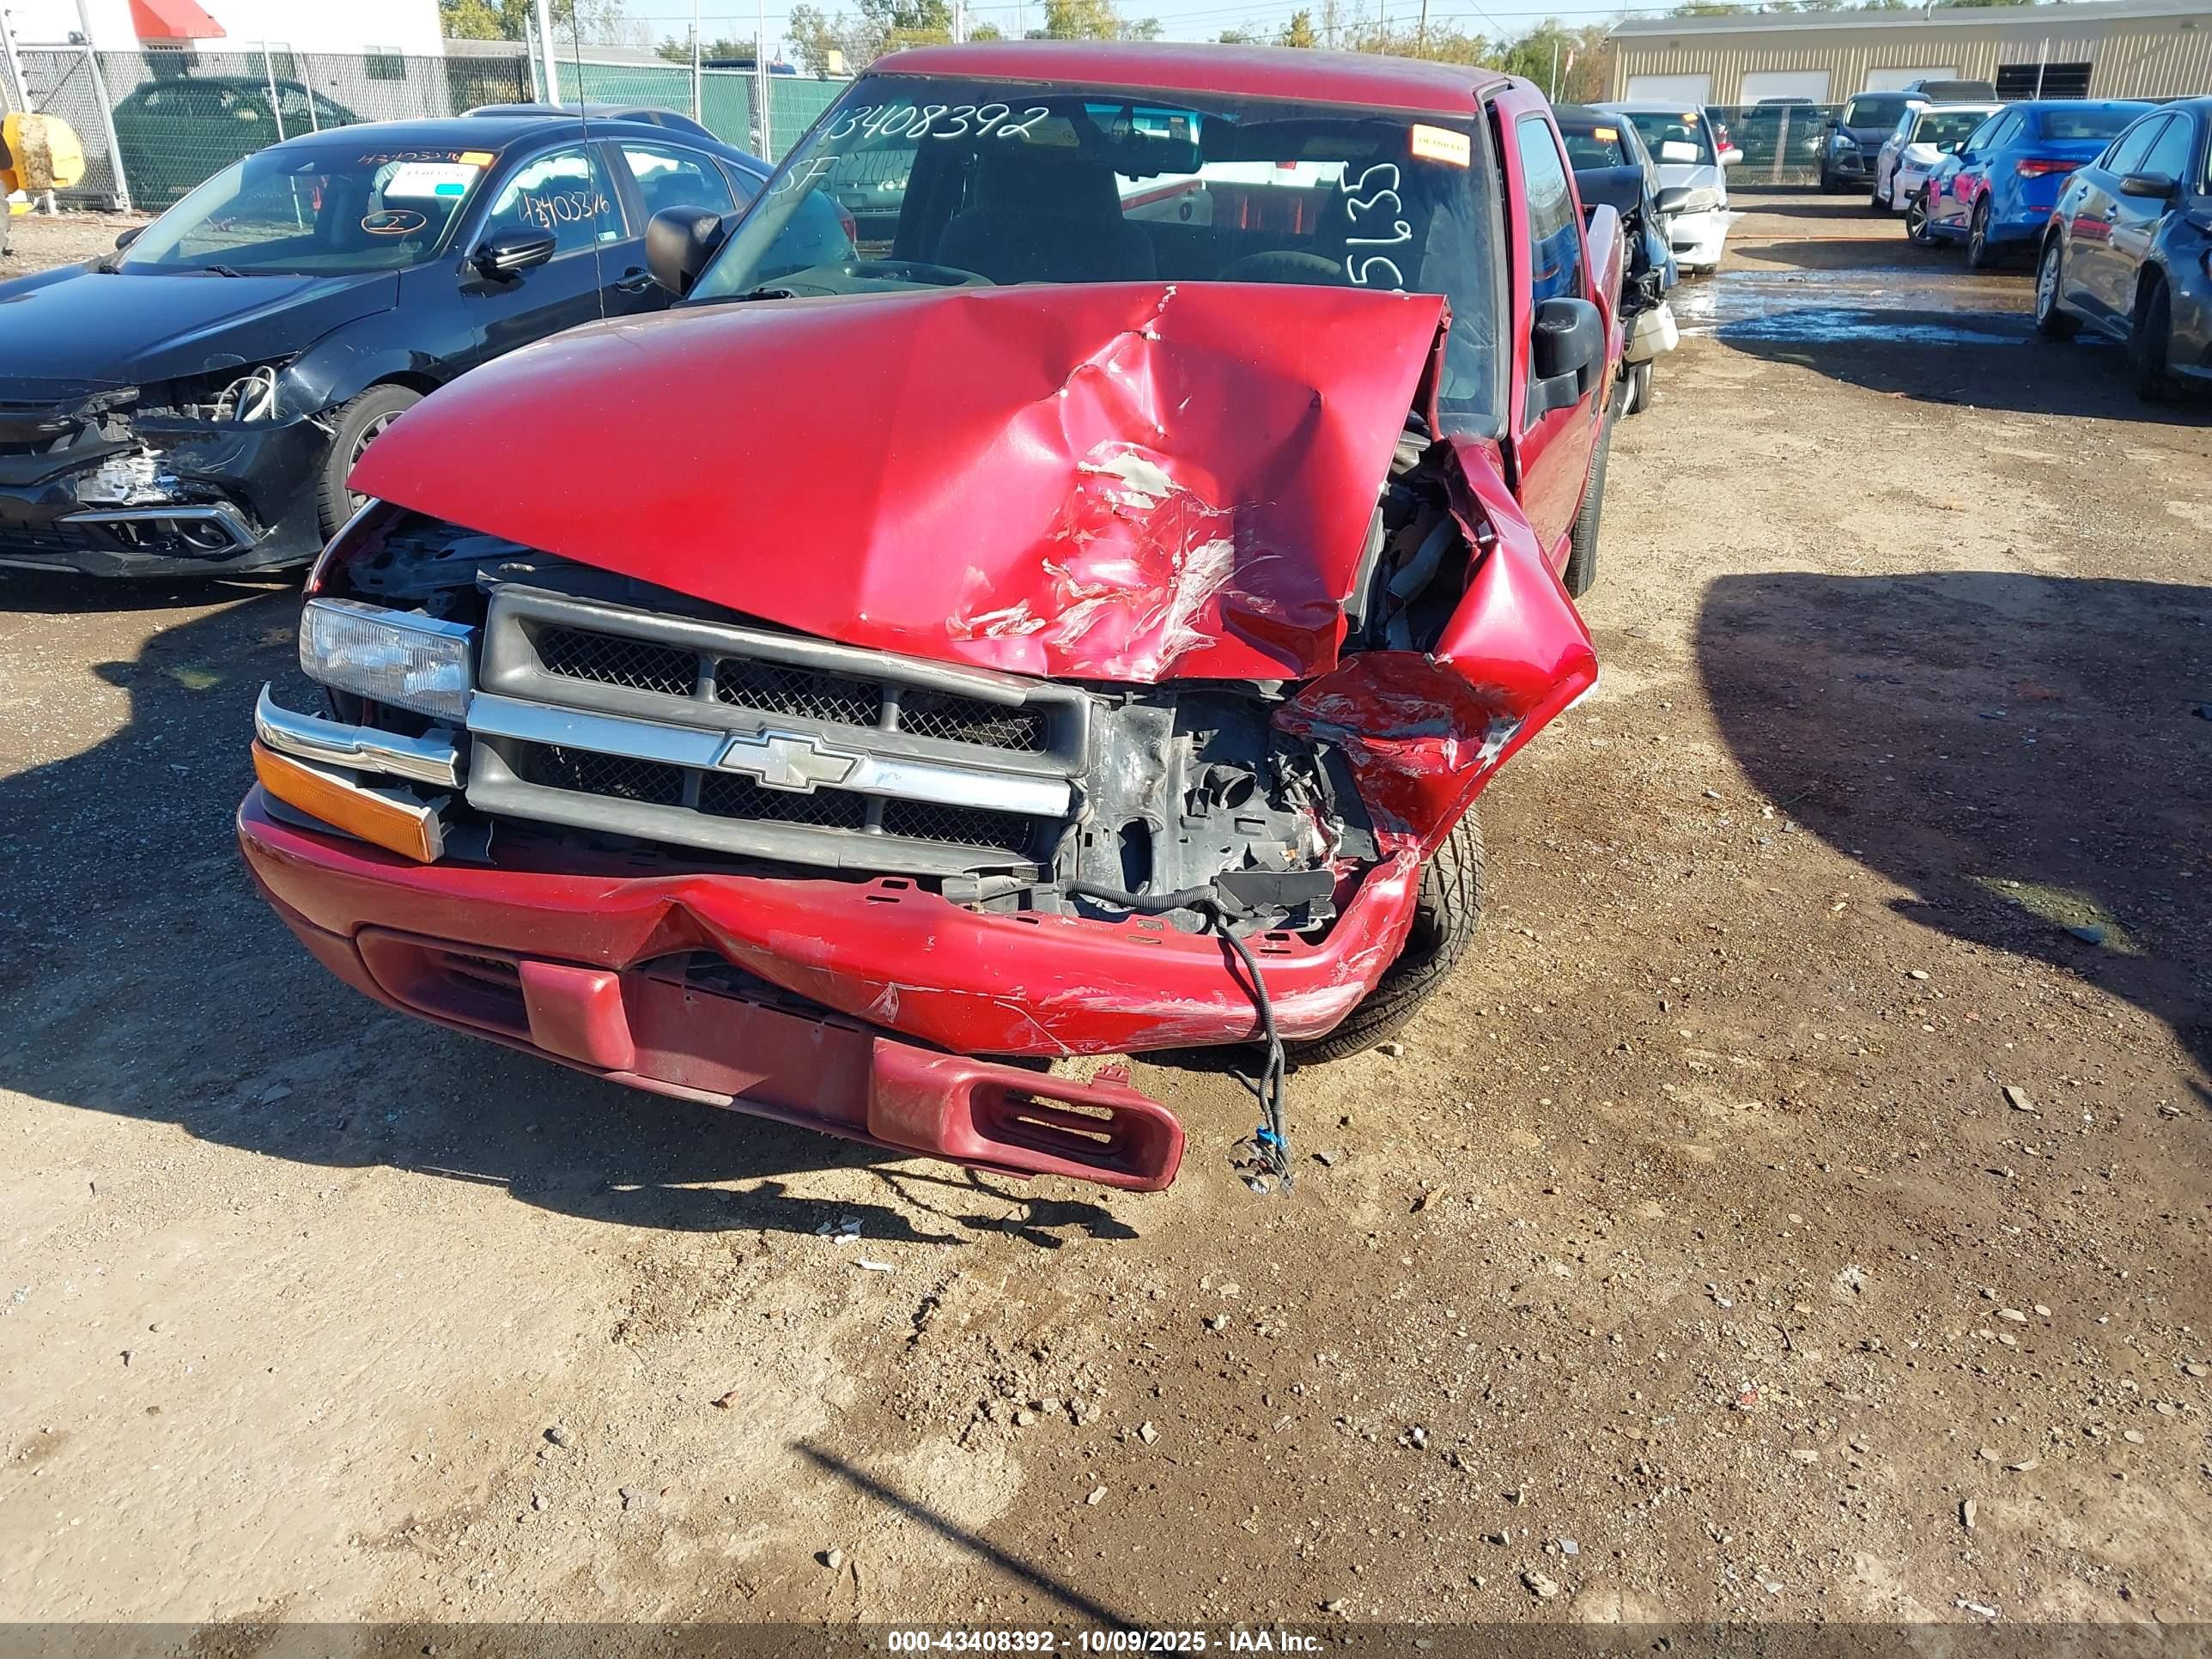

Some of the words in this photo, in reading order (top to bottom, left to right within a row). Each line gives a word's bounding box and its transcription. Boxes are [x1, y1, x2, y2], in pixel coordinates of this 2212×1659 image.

[815, 103, 1050, 141] 43408392
[769, 156, 841, 195] SF
[1340, 161, 1413, 293] 5635
